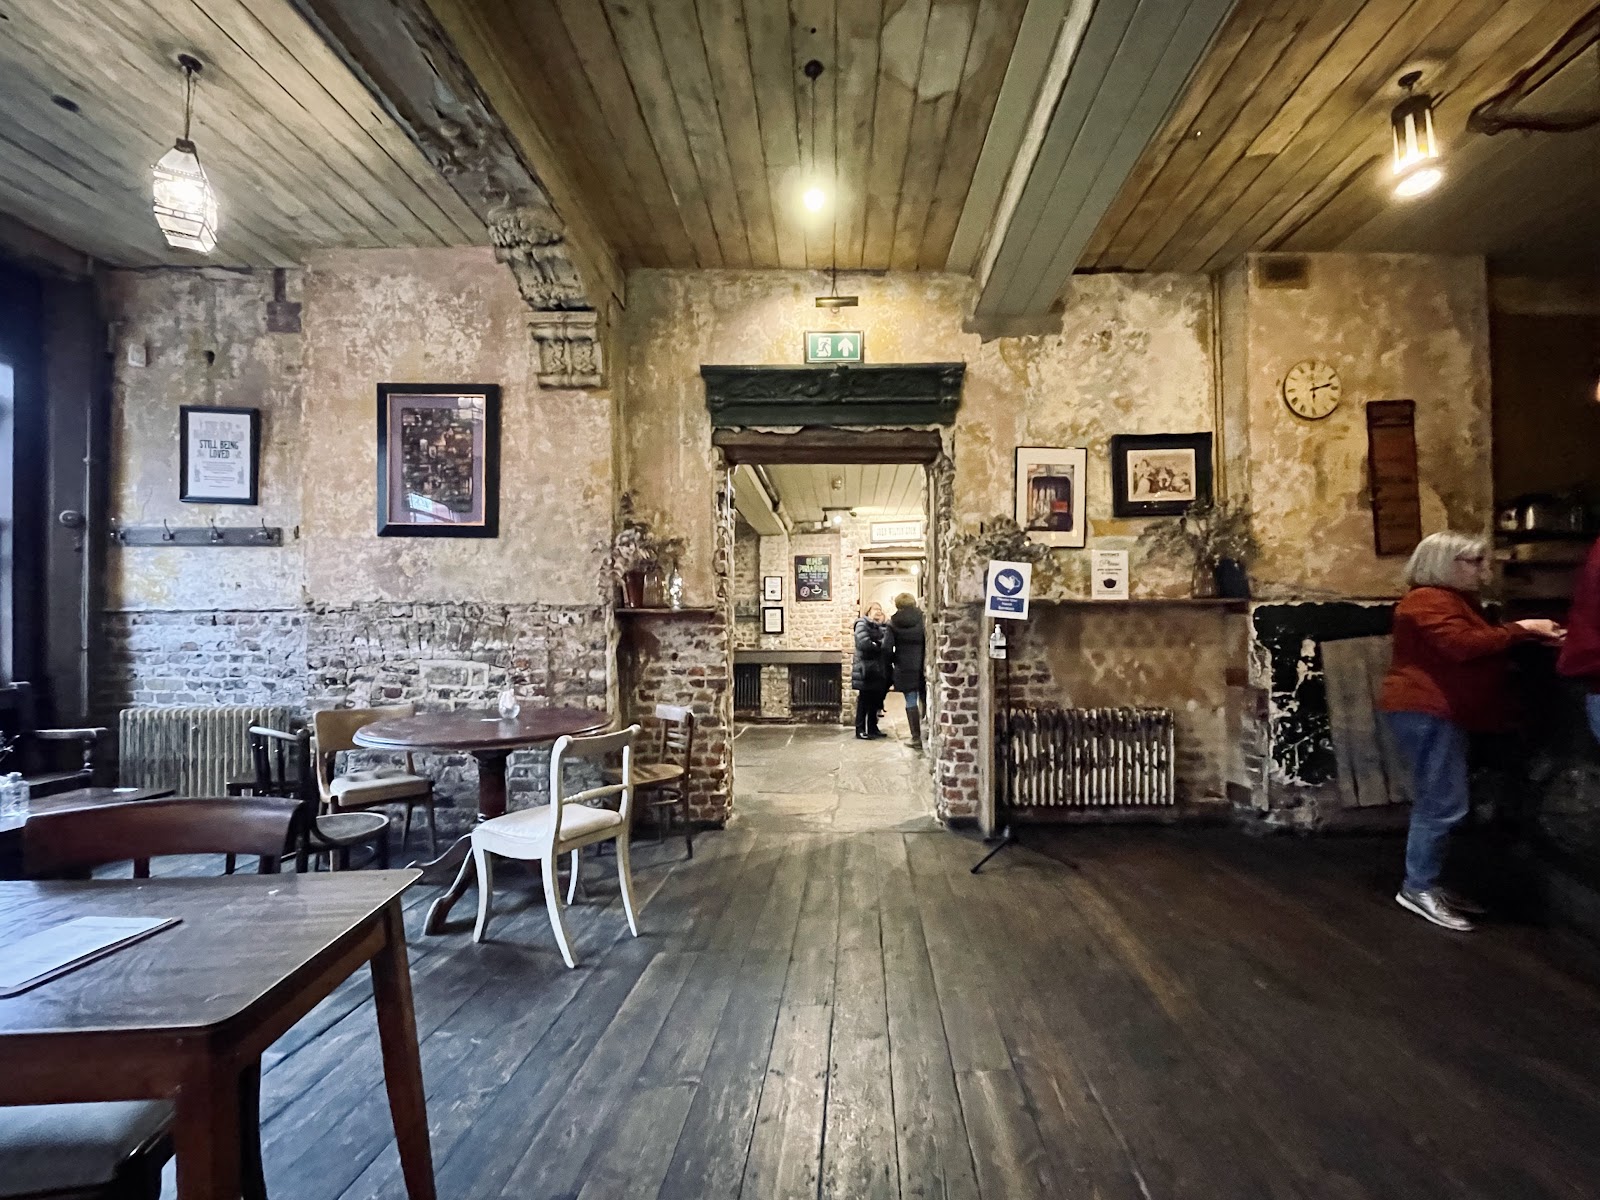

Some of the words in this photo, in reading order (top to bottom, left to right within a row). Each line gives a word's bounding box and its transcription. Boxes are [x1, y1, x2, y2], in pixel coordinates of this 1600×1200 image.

[199, 439, 218, 449] STILL
[219, 440, 239, 450] BEING
[209, 449, 230, 459] LOVED
